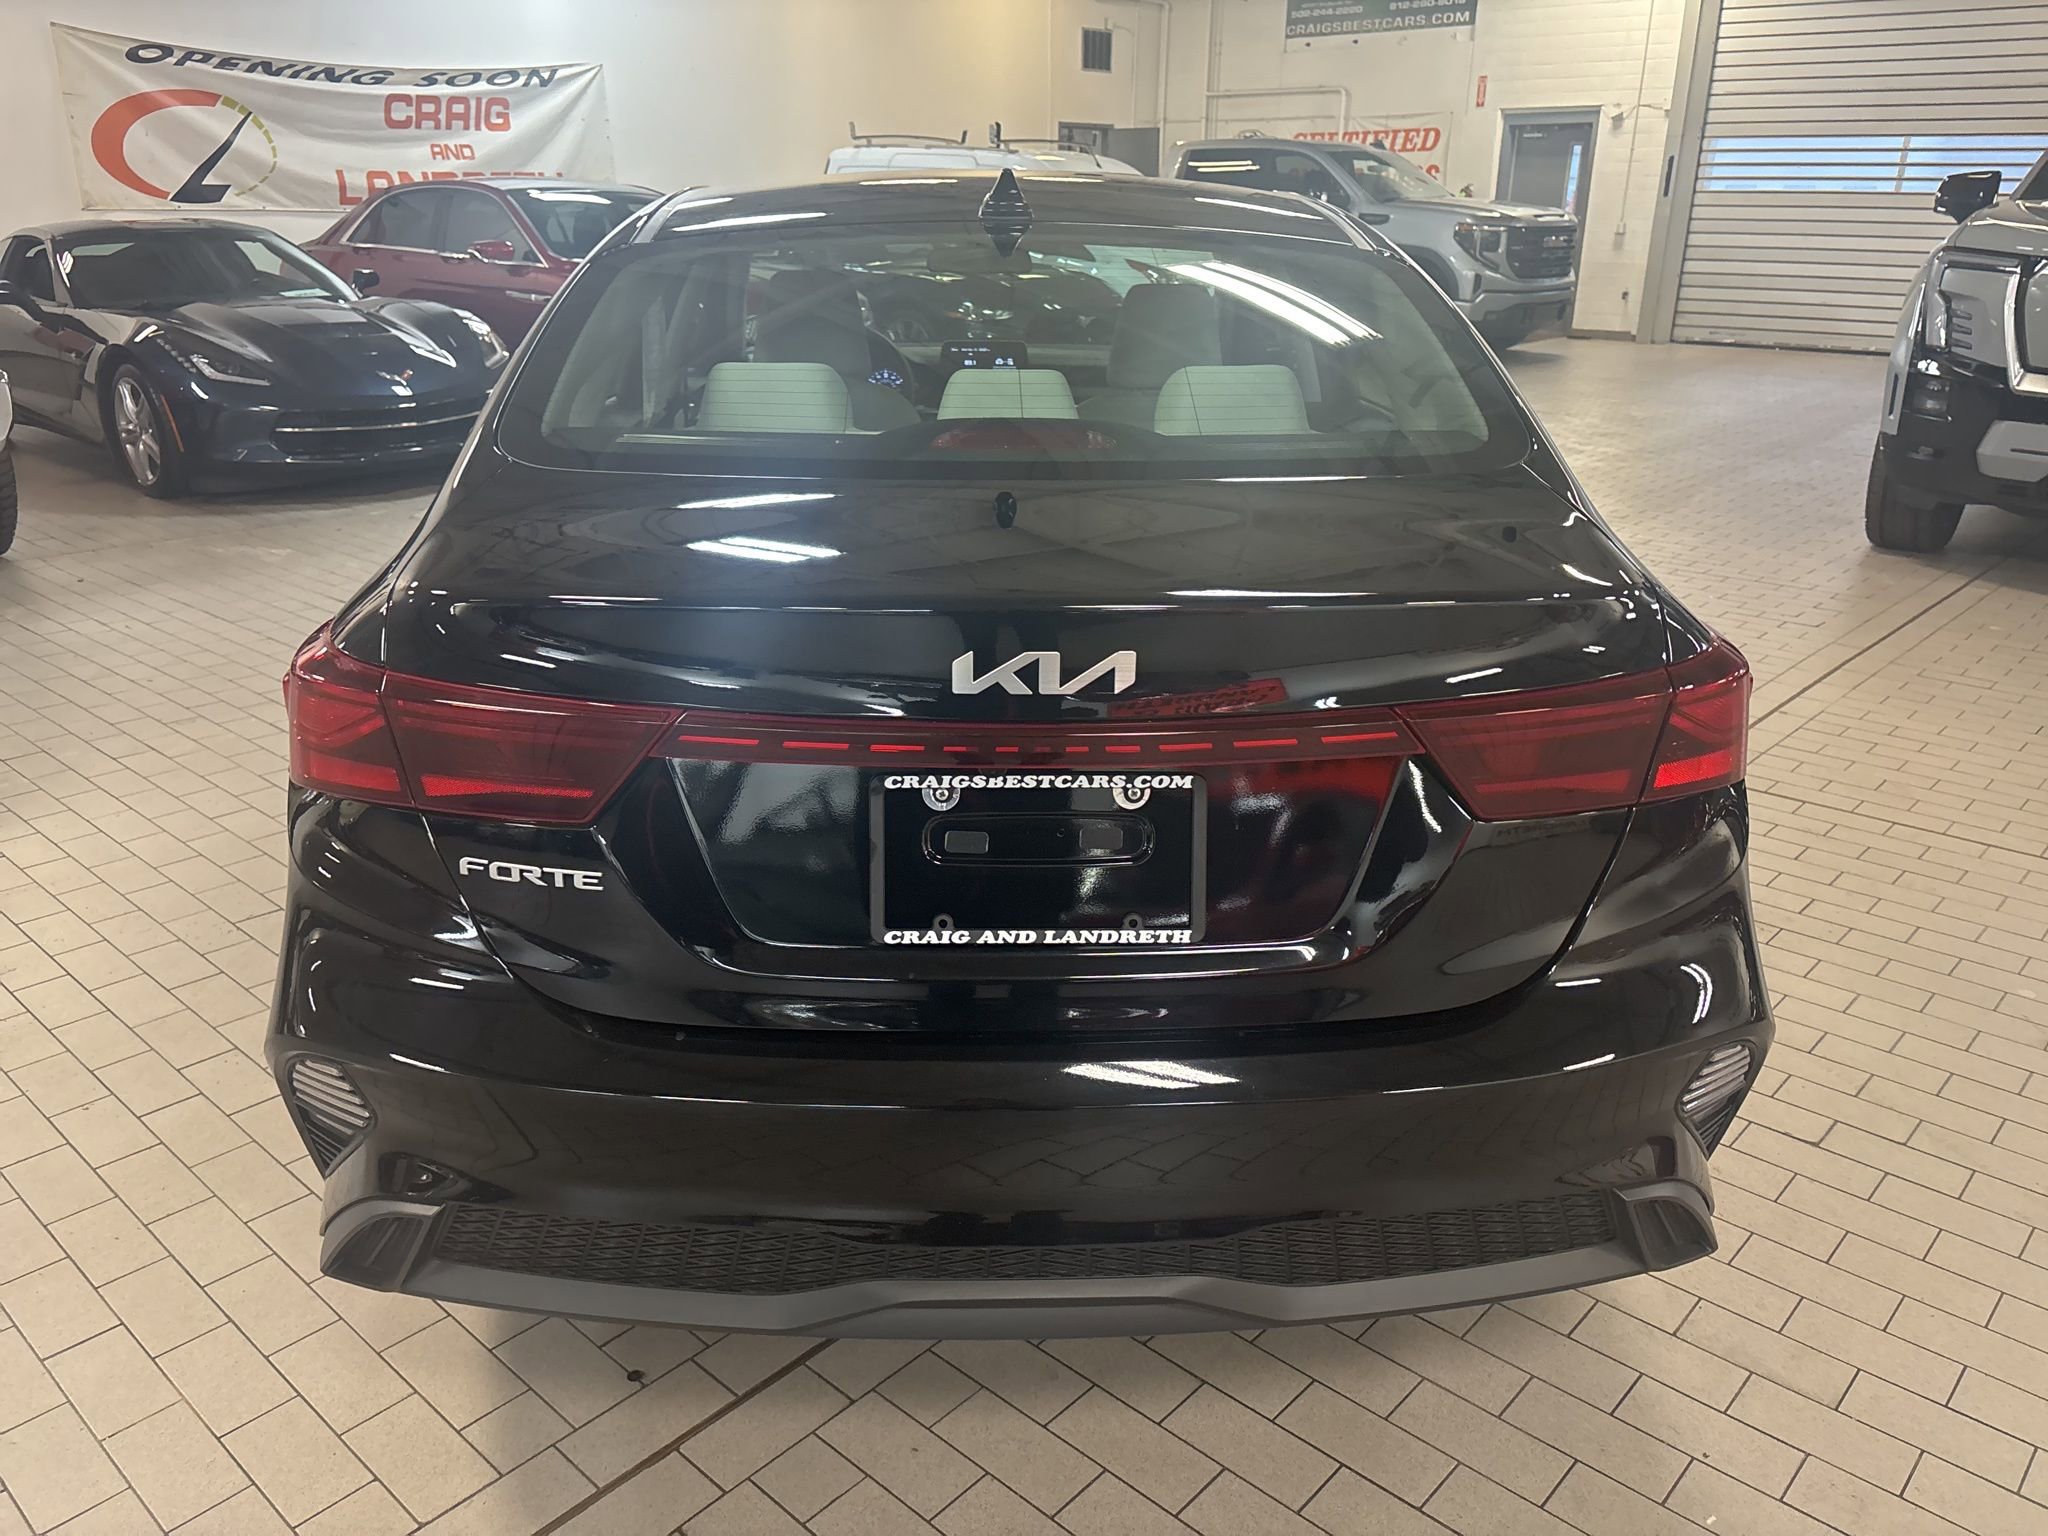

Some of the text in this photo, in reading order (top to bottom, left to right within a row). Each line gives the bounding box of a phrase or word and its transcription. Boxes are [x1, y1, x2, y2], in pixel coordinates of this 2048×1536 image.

[1287, 11, 1470, 36] CRAIGSBESTCARS.COM
[125, 44, 559, 88] OPENING SOON
[384, 93, 512, 132] CRAIG
[430, 143, 476, 161] AND
[952, 650, 1137, 695] KIA
[884, 775, 1194, 789] CRAIGSBESTCARS.COM
[459, 856, 604, 891] FORTE
[884, 929, 1193, 945] CRAIG AND LANDRETH
